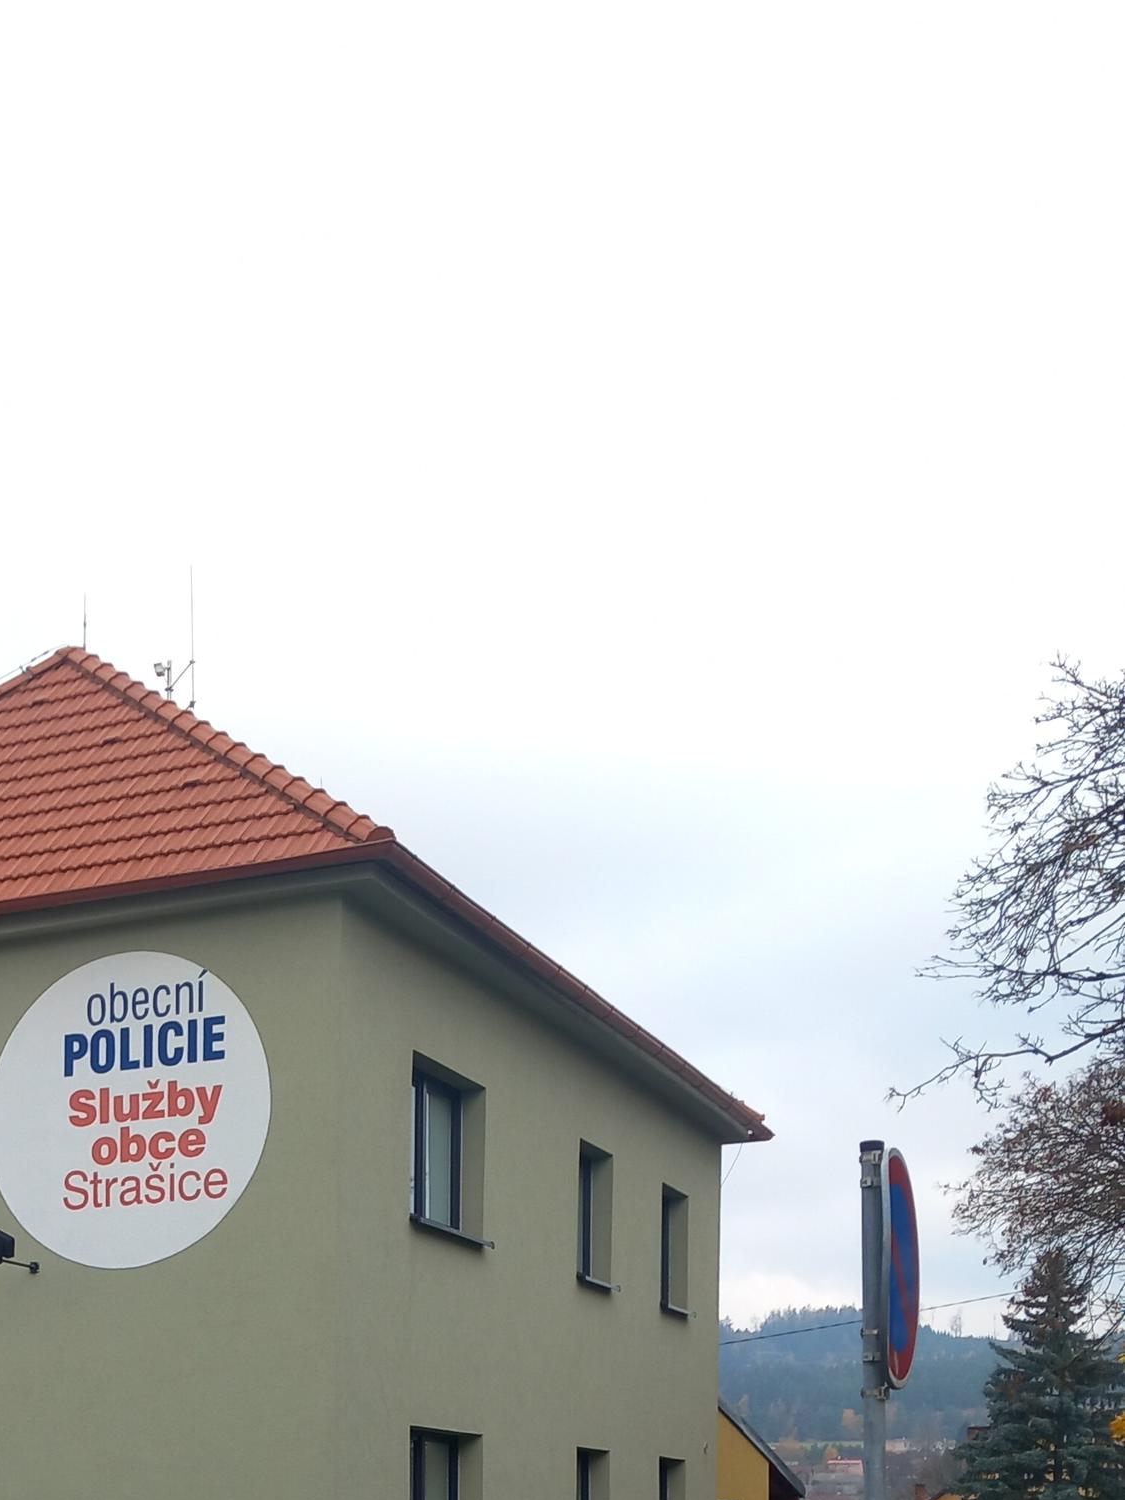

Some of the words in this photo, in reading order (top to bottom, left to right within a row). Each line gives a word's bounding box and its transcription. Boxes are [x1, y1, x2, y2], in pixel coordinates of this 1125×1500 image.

[86, 968, 210, 1026] obecní
[64, 1015, 226, 1077] POLICIE
[68, 1079, 223, 1127] Služby
[91, 1126, 206, 1165] obce
[63, 1162, 228, 1210] Strašice
